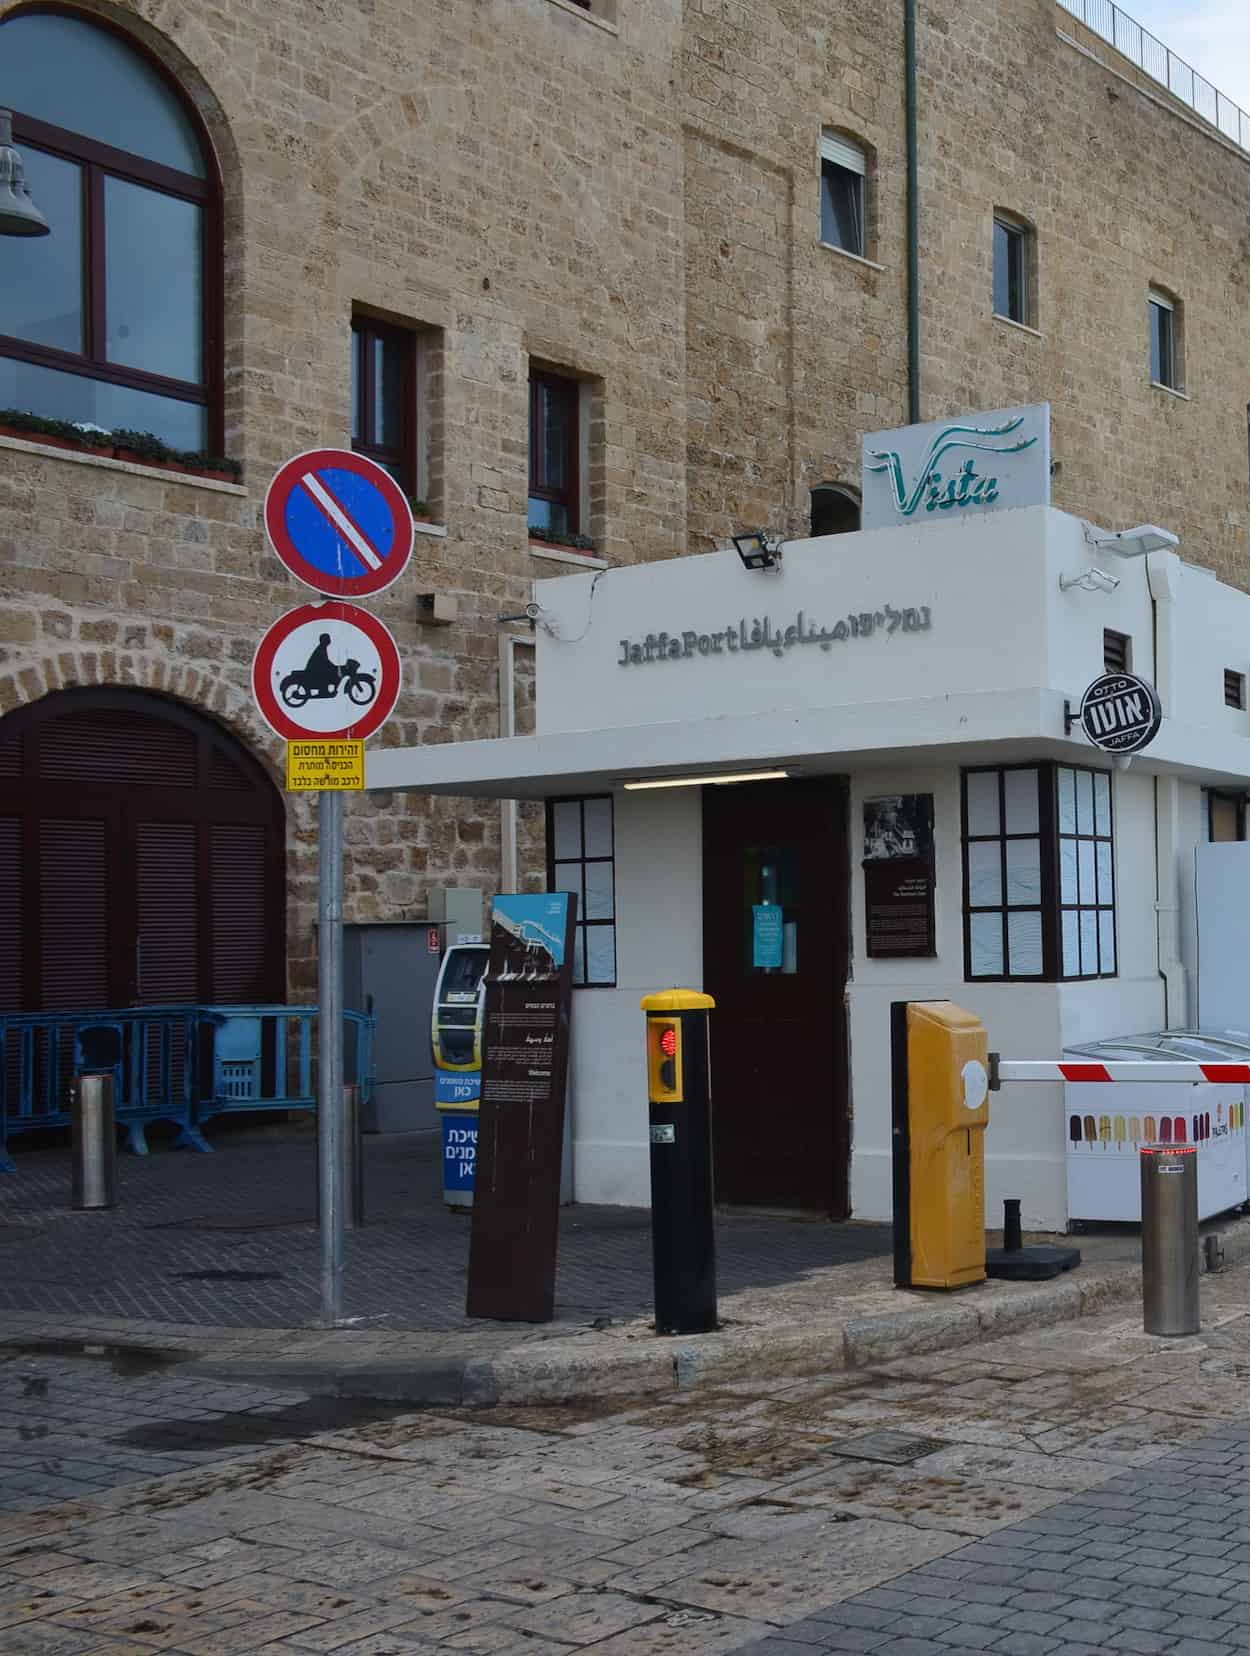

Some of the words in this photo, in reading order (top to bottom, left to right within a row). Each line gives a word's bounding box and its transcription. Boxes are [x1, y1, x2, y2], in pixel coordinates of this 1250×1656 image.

[1094, 680, 1127, 696] OTTO
[1090, 693, 1144, 735] אוטו
[1109, 732, 1140, 746] JAFFA
[293, 745, 326, 756] מחסום
[328, 745, 358, 756] זהירות
